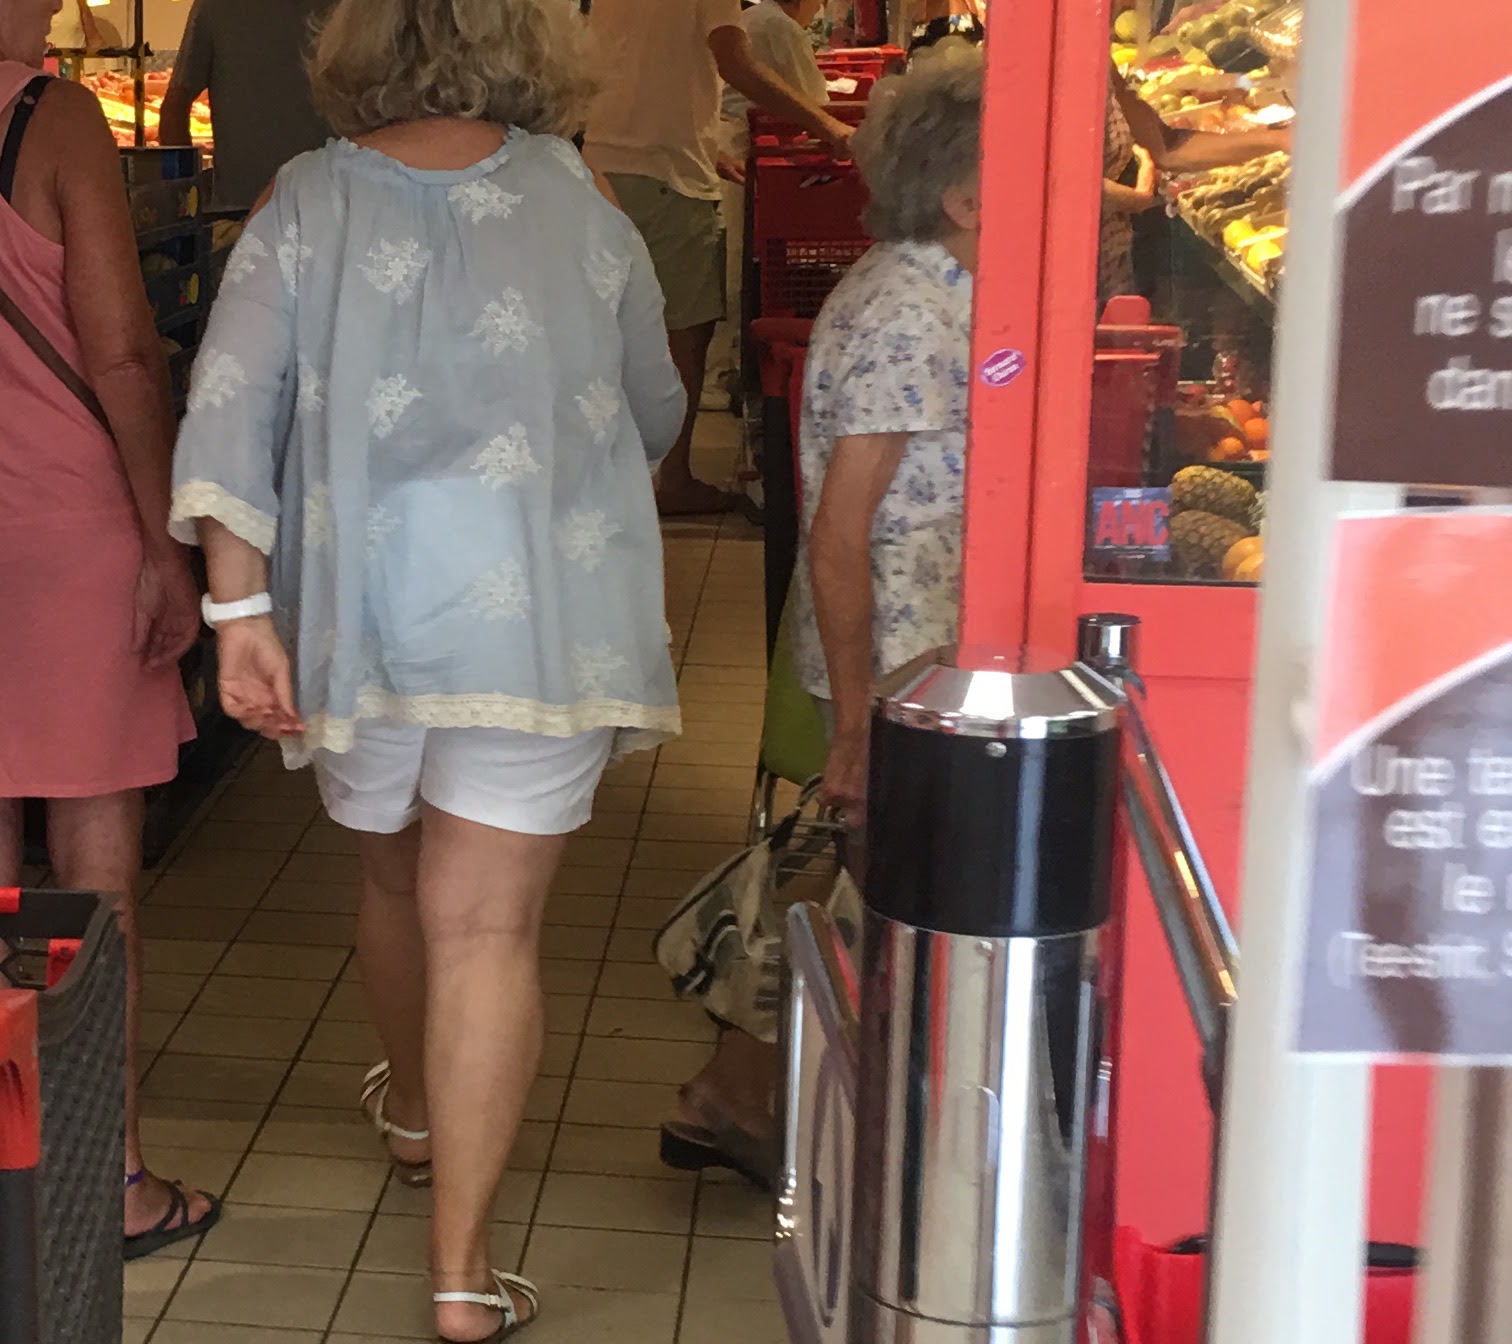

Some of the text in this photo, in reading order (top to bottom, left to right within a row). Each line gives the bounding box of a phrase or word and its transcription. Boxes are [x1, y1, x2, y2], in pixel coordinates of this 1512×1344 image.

[1393, 156, 1481, 214] Par
[1413, 293, 1481, 338] ne
[1350, 743, 1457, 796] Une
[1384, 801, 1468, 849] est
[1443, 861, 1496, 915] le
